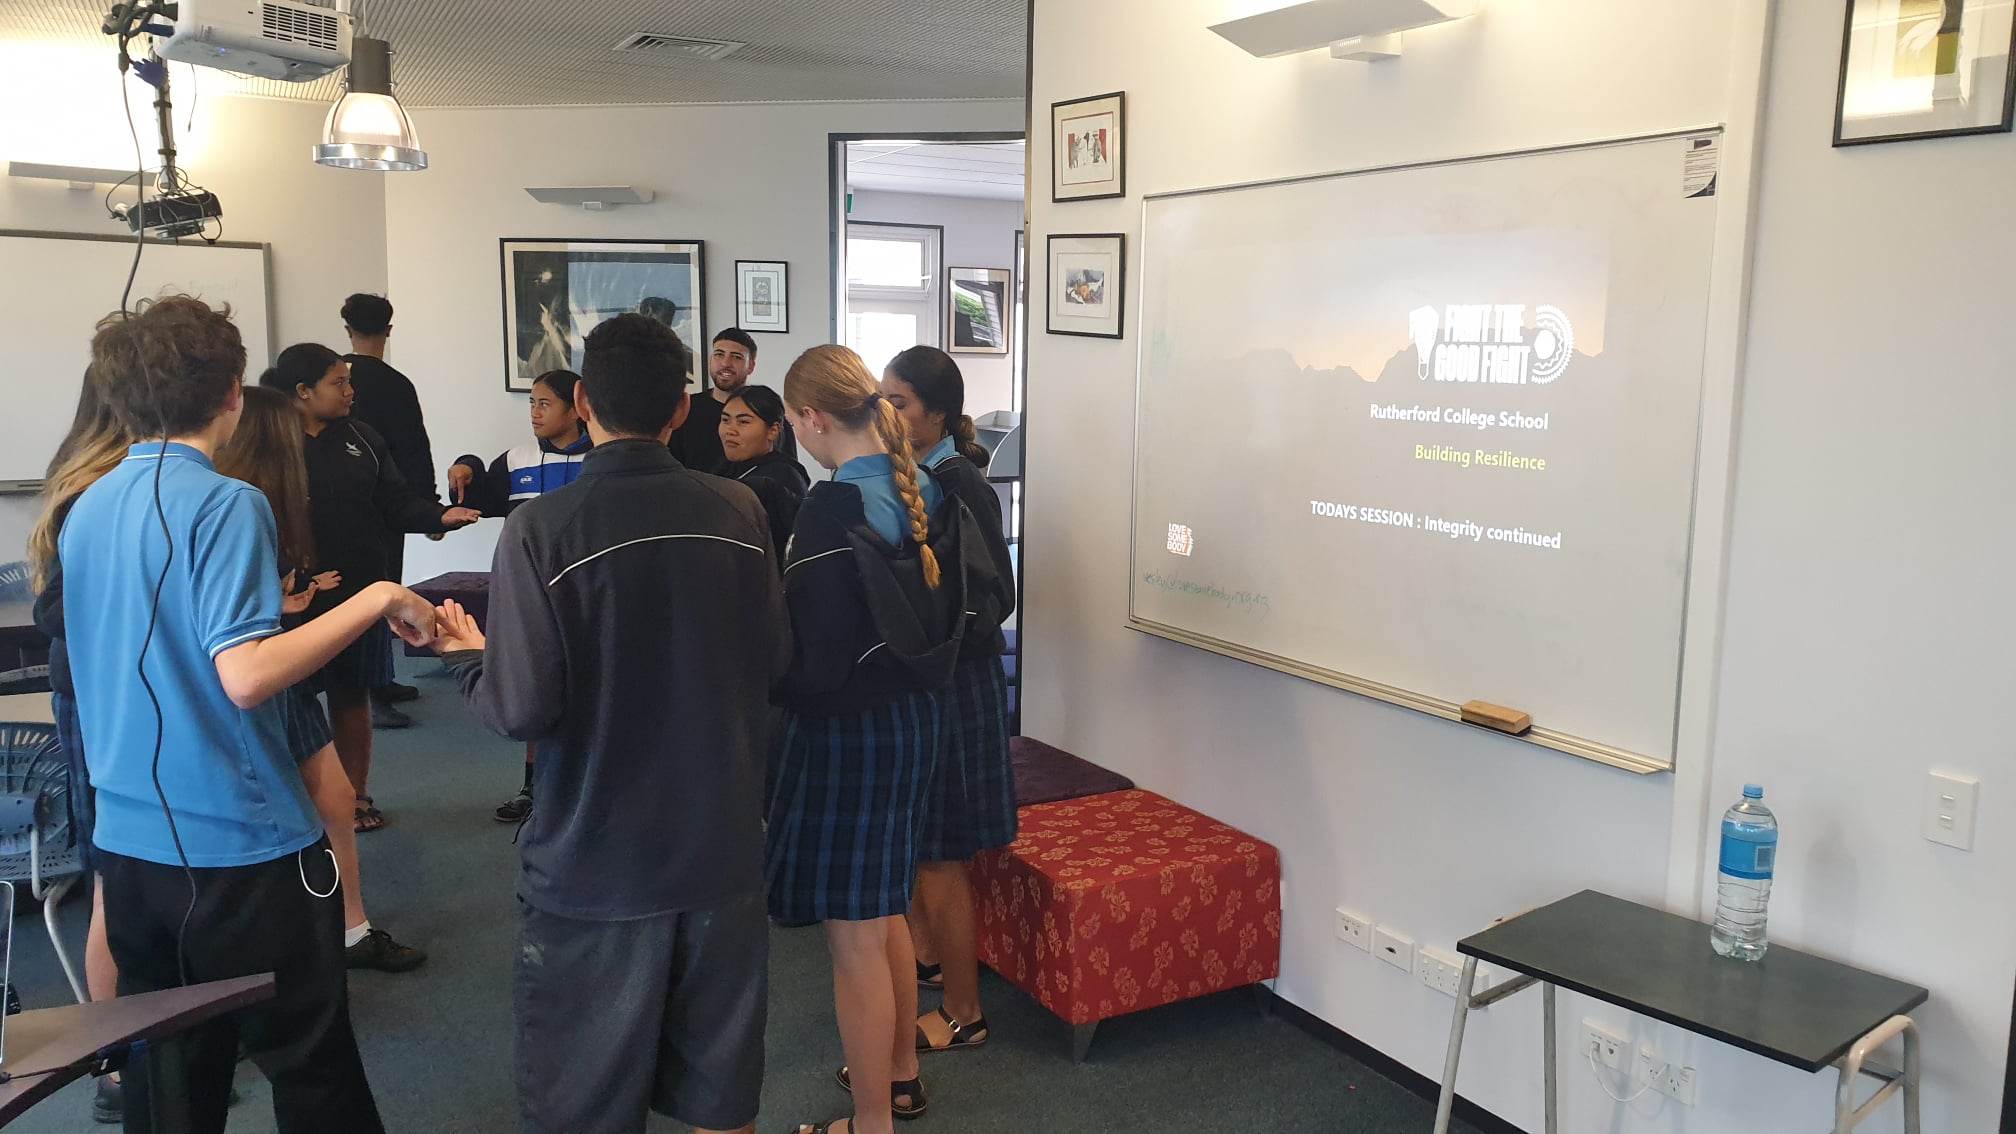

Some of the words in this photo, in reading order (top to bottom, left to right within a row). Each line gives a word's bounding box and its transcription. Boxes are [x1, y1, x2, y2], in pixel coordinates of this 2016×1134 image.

[1434, 343, 1481, 383] GOOD
[1370, 403, 1441, 423] Rutherford
[1444, 407, 1496, 430] College
[1499, 411, 1549, 430] School
[1415, 444, 1471, 468] Building
[1475, 449, 1546, 471] Resilience
[1167, 532, 1188, 543] SOME
[1168, 523, 1187, 534] LOVE
[1310, 500, 1358, 520] TODAYS
[1359, 506, 1414, 528] SESSION
[1424, 515, 1484, 542] Integrity
[1486, 526, 1562, 549] continued
